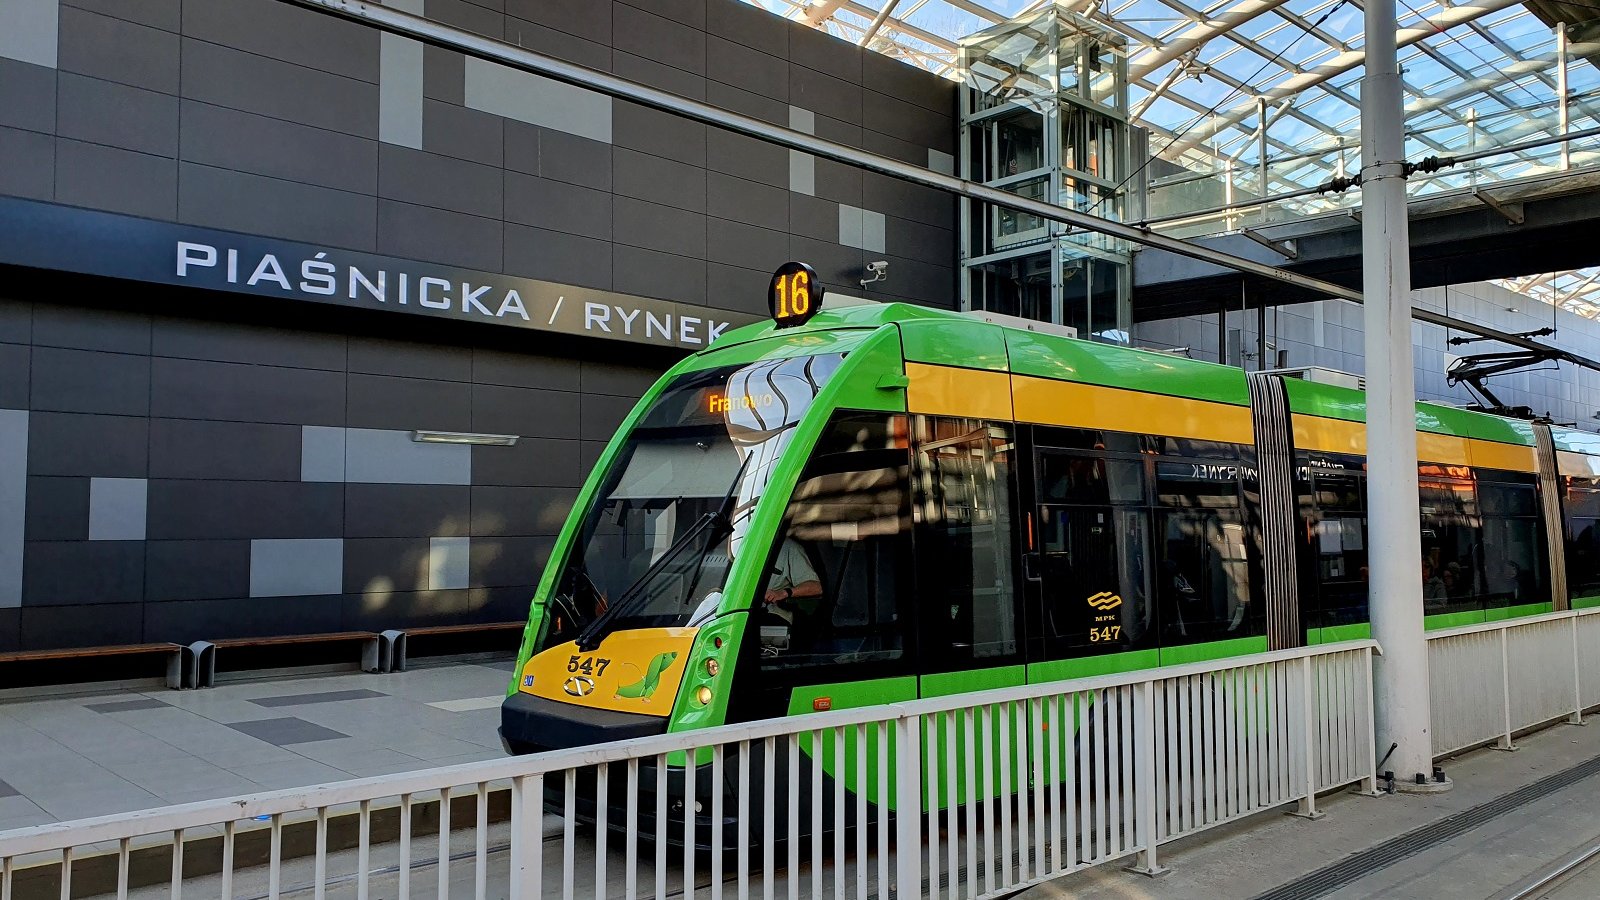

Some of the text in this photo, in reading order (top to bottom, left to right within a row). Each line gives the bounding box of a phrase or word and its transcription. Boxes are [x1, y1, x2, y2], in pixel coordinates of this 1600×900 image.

[176, 241, 731, 346] PIAŚNICKA / RYNEK
[775, 270, 809, 318] 16
[1090, 625, 1121, 642] 547
[567, 655, 611, 677] 547
